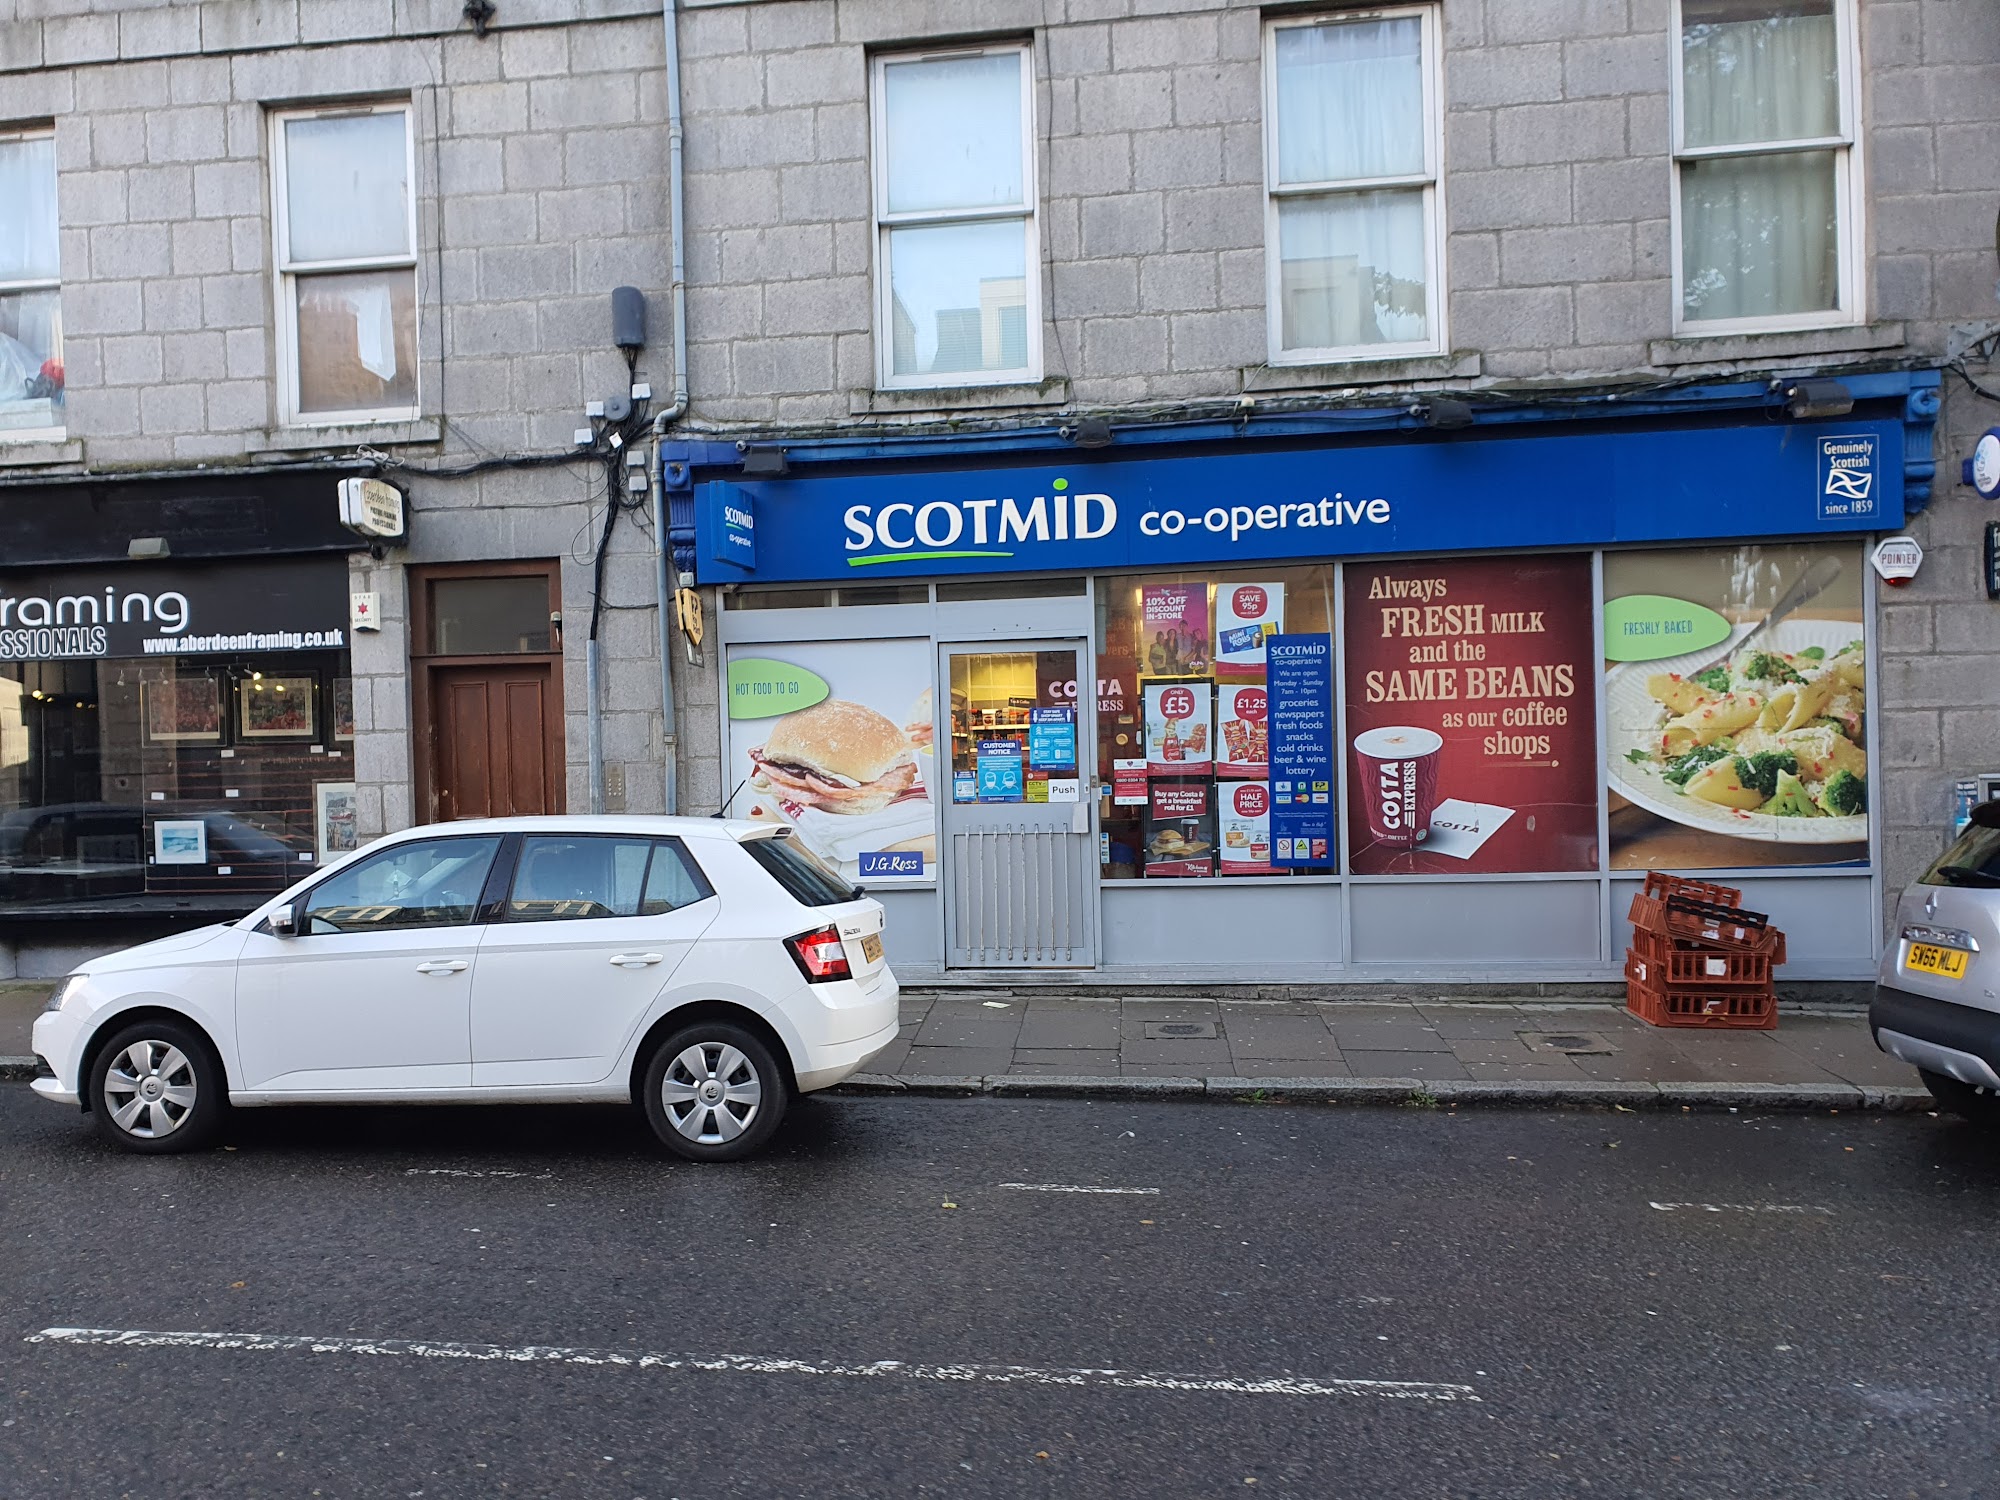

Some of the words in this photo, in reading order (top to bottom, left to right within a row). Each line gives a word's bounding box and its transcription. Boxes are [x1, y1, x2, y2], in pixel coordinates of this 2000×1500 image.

[1824, 440, 1873, 455] Genuinely
[1830, 455, 1870, 469] Scottish
[1825, 502, 1848, 514] since
[1851, 500, 1873, 513] 1859
[725, 505, 754, 530] SCOTMID
[843, 478, 1117, 551] SCOTMID
[1139, 492, 1391, 541] co-operative
[729, 533, 752, 547] co-operative
[1881, 553, 1917, 565] POINTER
[1368, 575, 1447, 603] Always
[1146, 596, 1166, 606] 10%
[1167, 595, 1189, 605] OFF
[1240, 594, 1261, 602] SAVE
[0, 586, 188, 633] raming
[1146, 605, 1186, 613] DISCOUNT
[1242, 602, 1258, 611] 95p
[1146, 612, 1183, 620] IN-STORE
[1381, 604, 1485, 638] FRESH
[1491, 611, 1546, 634] MILK
[1624, 621, 1660, 635] FRESHLY
[1664, 620, 1693, 634] BAKED
[143, 627, 344, 654] www.aberdeenframing.co.uk
[1232, 634, 1251, 647] ROLLS
[1271, 642, 1326, 656] SCOTMID
[1409, 640, 1448, 663] and
[1453, 639, 1486, 661] the
[1275, 657, 1322, 666] co-operative
[735, 682, 750, 696] HOT
[753, 682, 772, 695] FOOD
[776, 681, 785, 694] TO
[788, 681, 799, 694] GO
[1366, 668, 1457, 703] SAME
[1465, 664, 1575, 699] BEANS
[1300, 687, 1317, 695] 10pm
[1165, 697, 1190, 714] £5
[1237, 698, 1267, 709] £1.25
[1280, 698, 1319, 709] groceries
[1275, 711, 1324, 721] newspapers
[1442, 712, 1463, 728] as
[1467, 711, 1498, 727] our
[1502, 701, 1568, 726] coffee
[1276, 721, 1297, 730] fresh
[1300, 720, 1324, 730] foods
[1286, 732, 1314, 741] snacks
[1276, 744, 1295, 752] cold
[1297, 743, 1324, 752] drinks
[1483, 730, 1550, 760] shops
[1274, 755, 1294, 764] beer
[1296, 755, 1304, 763] &
[1306, 755, 1327, 763] wine
[1285, 766, 1316, 777] lottery
[1052, 786, 1075, 794] Push
[1403, 760, 1417, 811] EXPRESS
[1155, 790, 1166, 798] Buy
[1240, 792, 1263, 801] HALF
[1380, 761, 1402, 829] COSTA
[1240, 800, 1263, 808] PRICE
[1433, 820, 1480, 834] COSTA
[864, 856, 918, 872] J.G.Ross
[1910, 945, 1939, 968] SW66
[1936, 950, 1964, 973] MLJ
